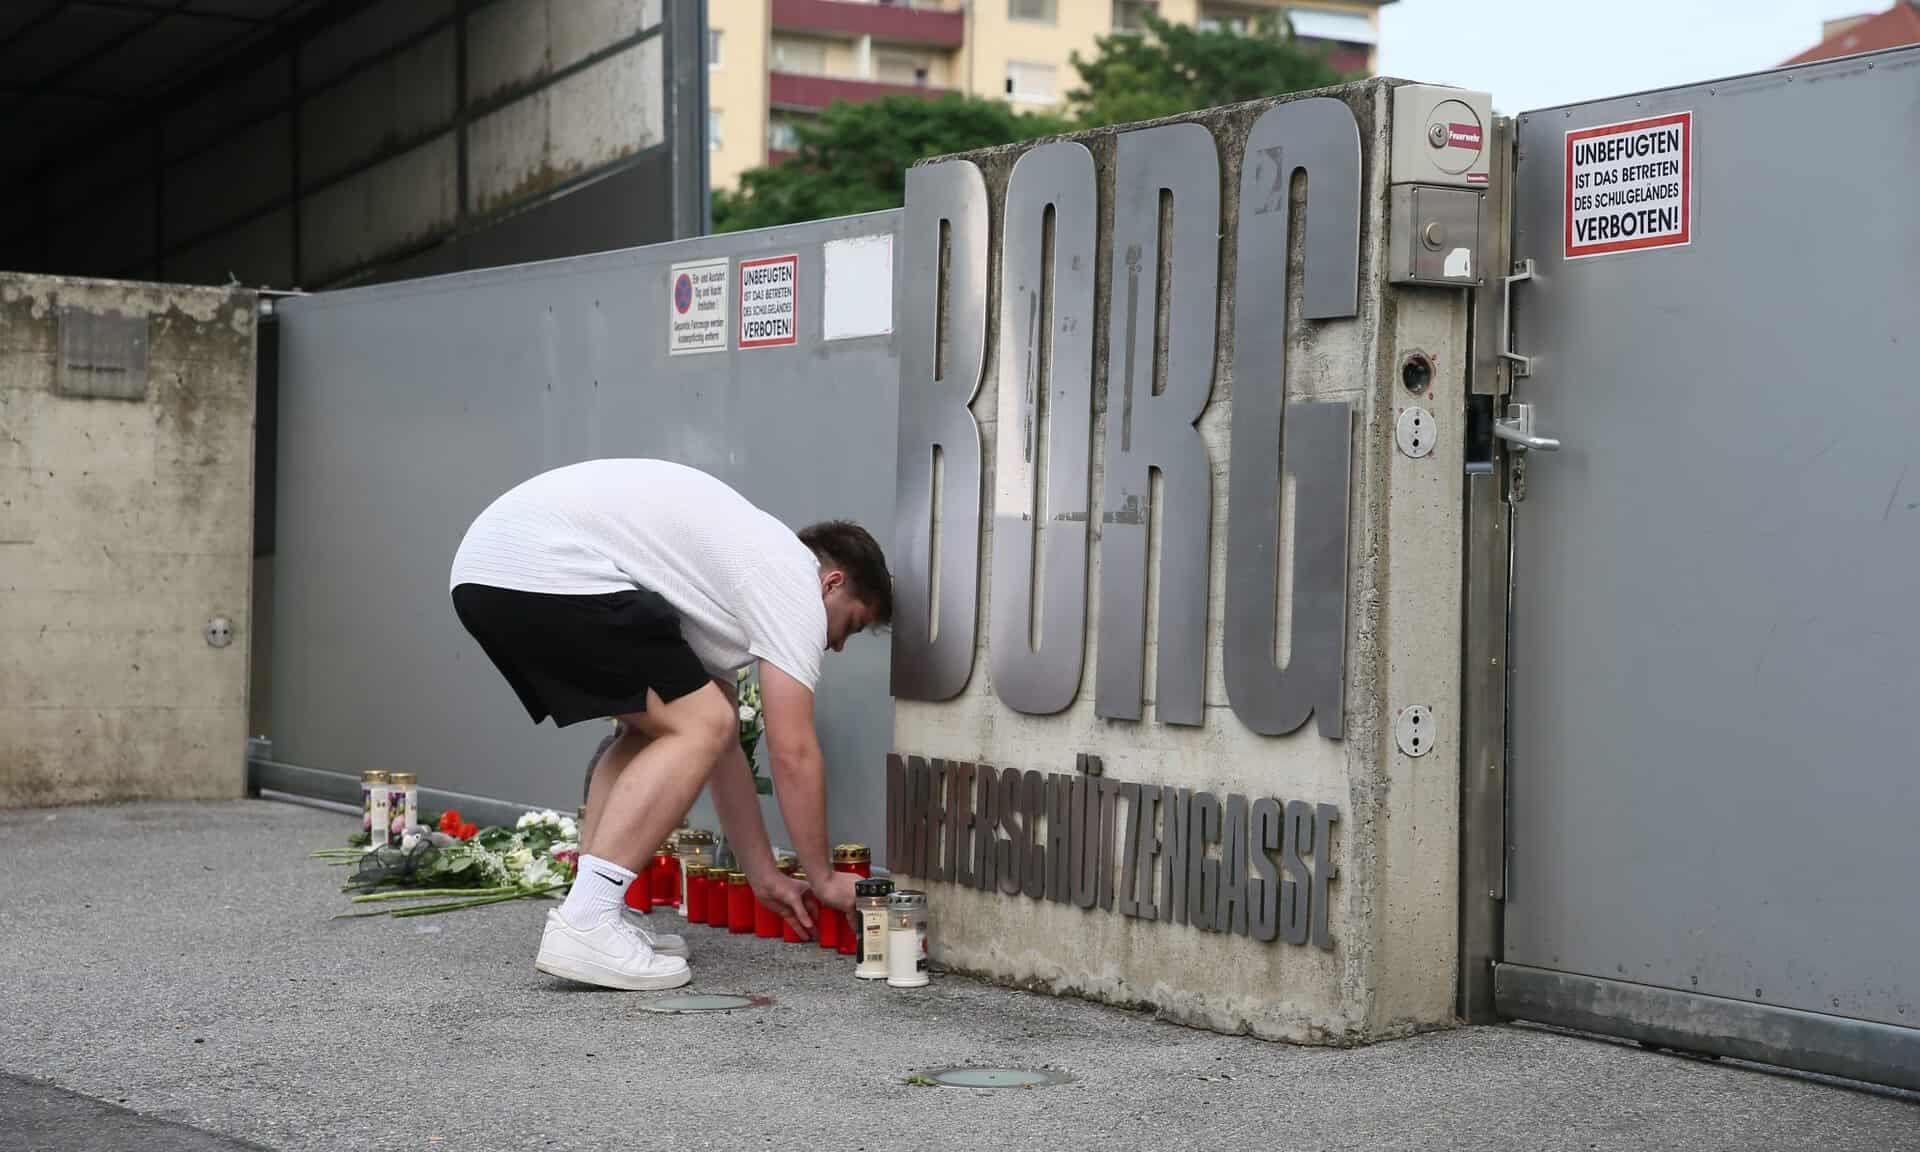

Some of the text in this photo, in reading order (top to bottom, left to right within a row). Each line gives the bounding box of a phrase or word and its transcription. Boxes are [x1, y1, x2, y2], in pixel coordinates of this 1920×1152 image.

[1575, 129, 1679, 166] UNBEFUGTEN
[1575, 160, 1679, 189] IST DAS BETRETEN
[1575, 182, 1679, 211] DES SCHULGELÄNDES
[1575, 206, 1679, 242] VERBOTEN!
[743, 265, 793, 286] UNBEFUGTEN
[743, 286, 793, 302] IST DAS BETRETEN
[743, 318, 792, 338] VERBOTEN!
[890, 97, 1362, 740] BORG
[886, 752, 1341, 951] DREIERSCHÜTZENGASSE
